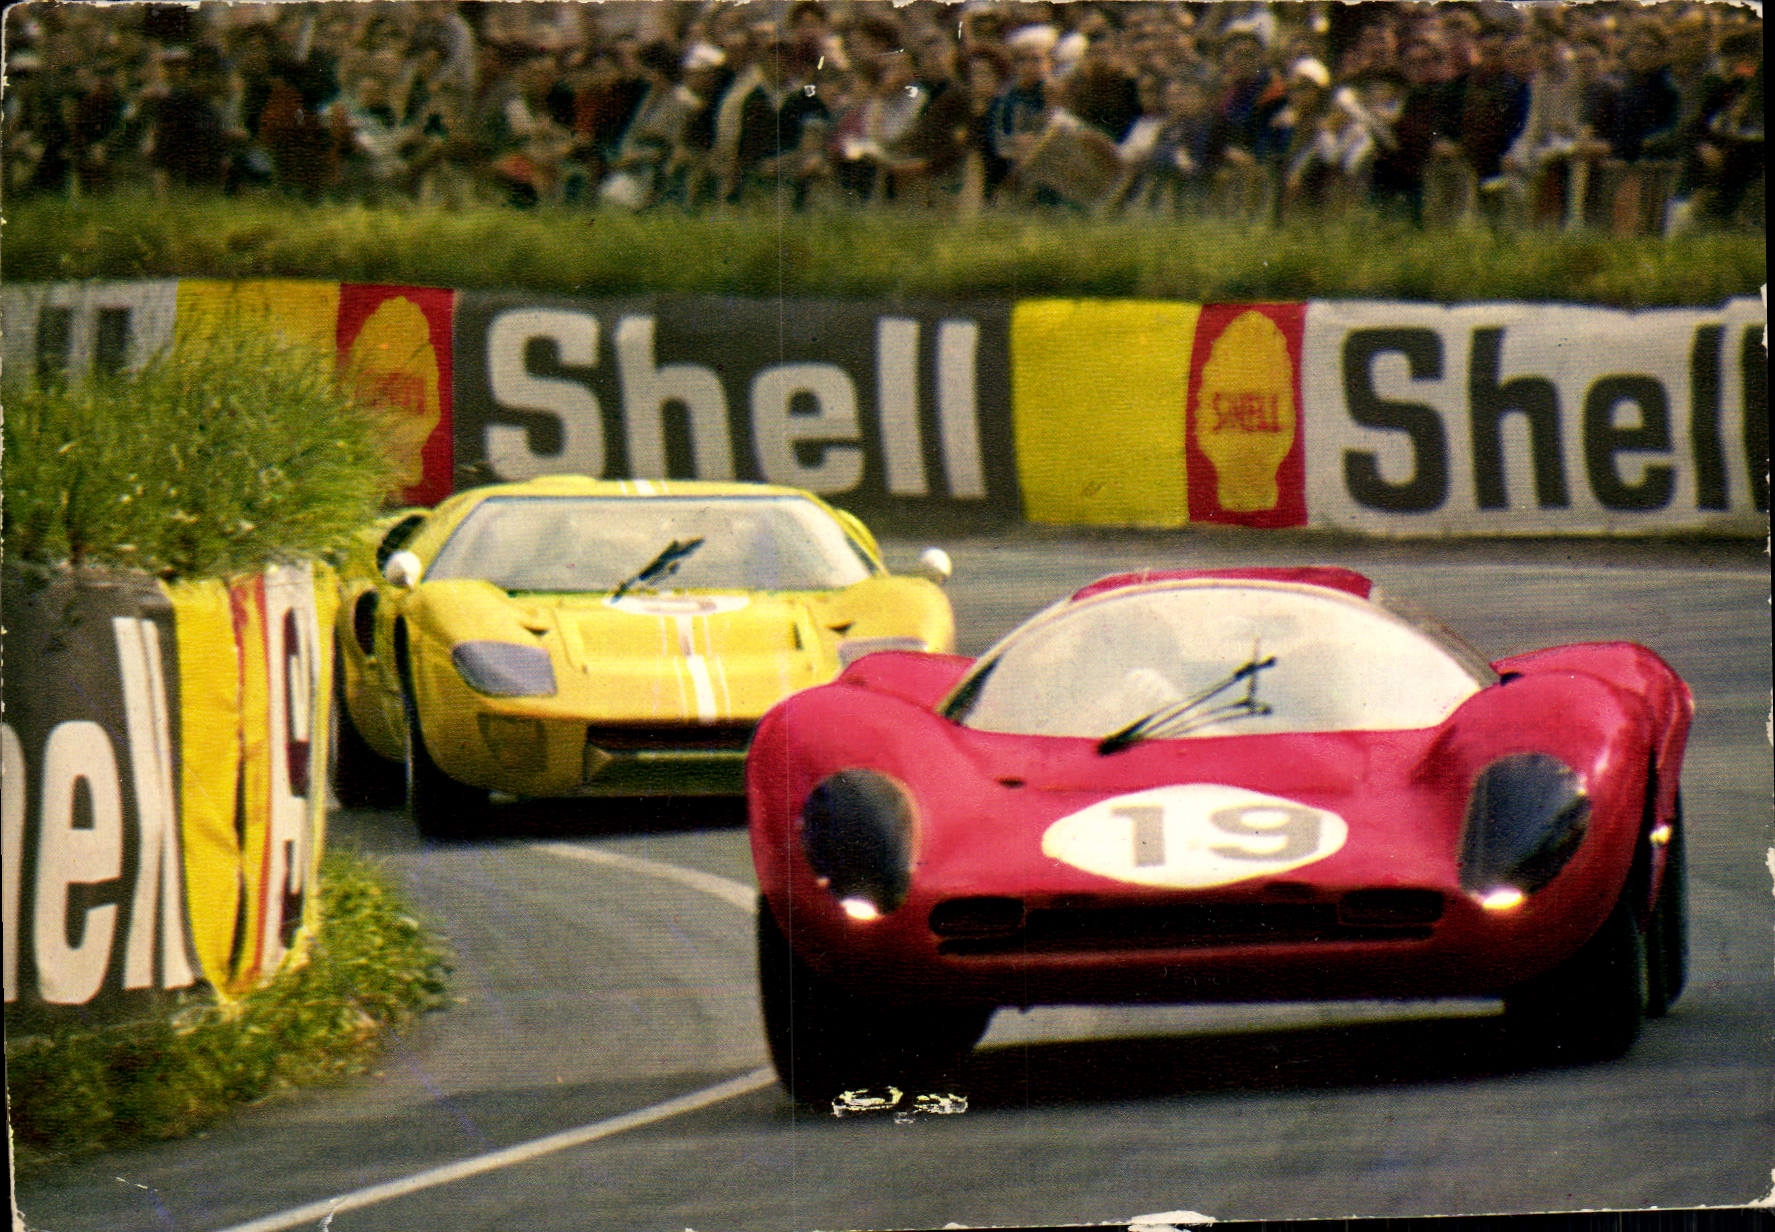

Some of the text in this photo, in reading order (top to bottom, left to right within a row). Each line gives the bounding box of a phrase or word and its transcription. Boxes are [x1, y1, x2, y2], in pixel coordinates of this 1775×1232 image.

[486, 308, 988, 498] Shell
[1341, 326, 1769, 514] Shell
[1111, 804, 1321, 867] 19
